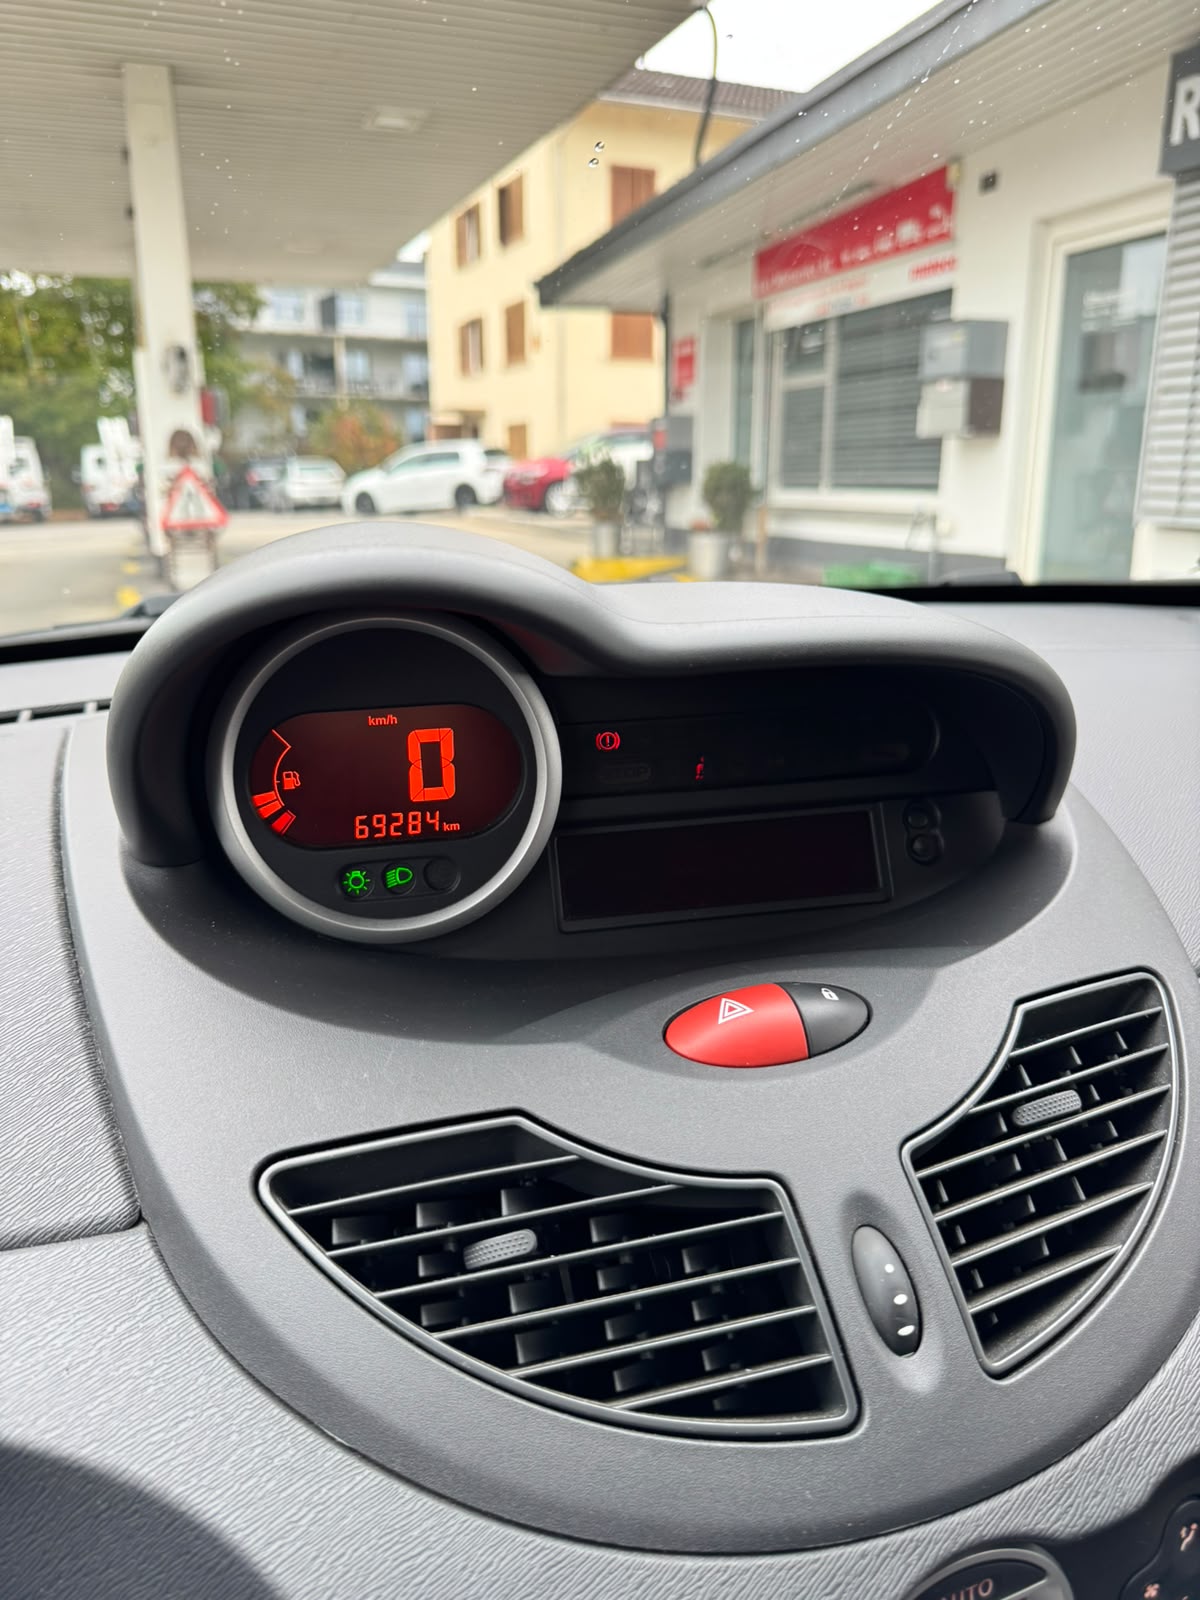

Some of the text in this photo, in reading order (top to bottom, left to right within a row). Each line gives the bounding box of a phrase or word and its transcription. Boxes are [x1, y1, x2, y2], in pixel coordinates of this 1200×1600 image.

[368, 714, 398, 726] km/h
[407, 727, 456, 803] 0
[354, 810, 460, 839] 69284 km
